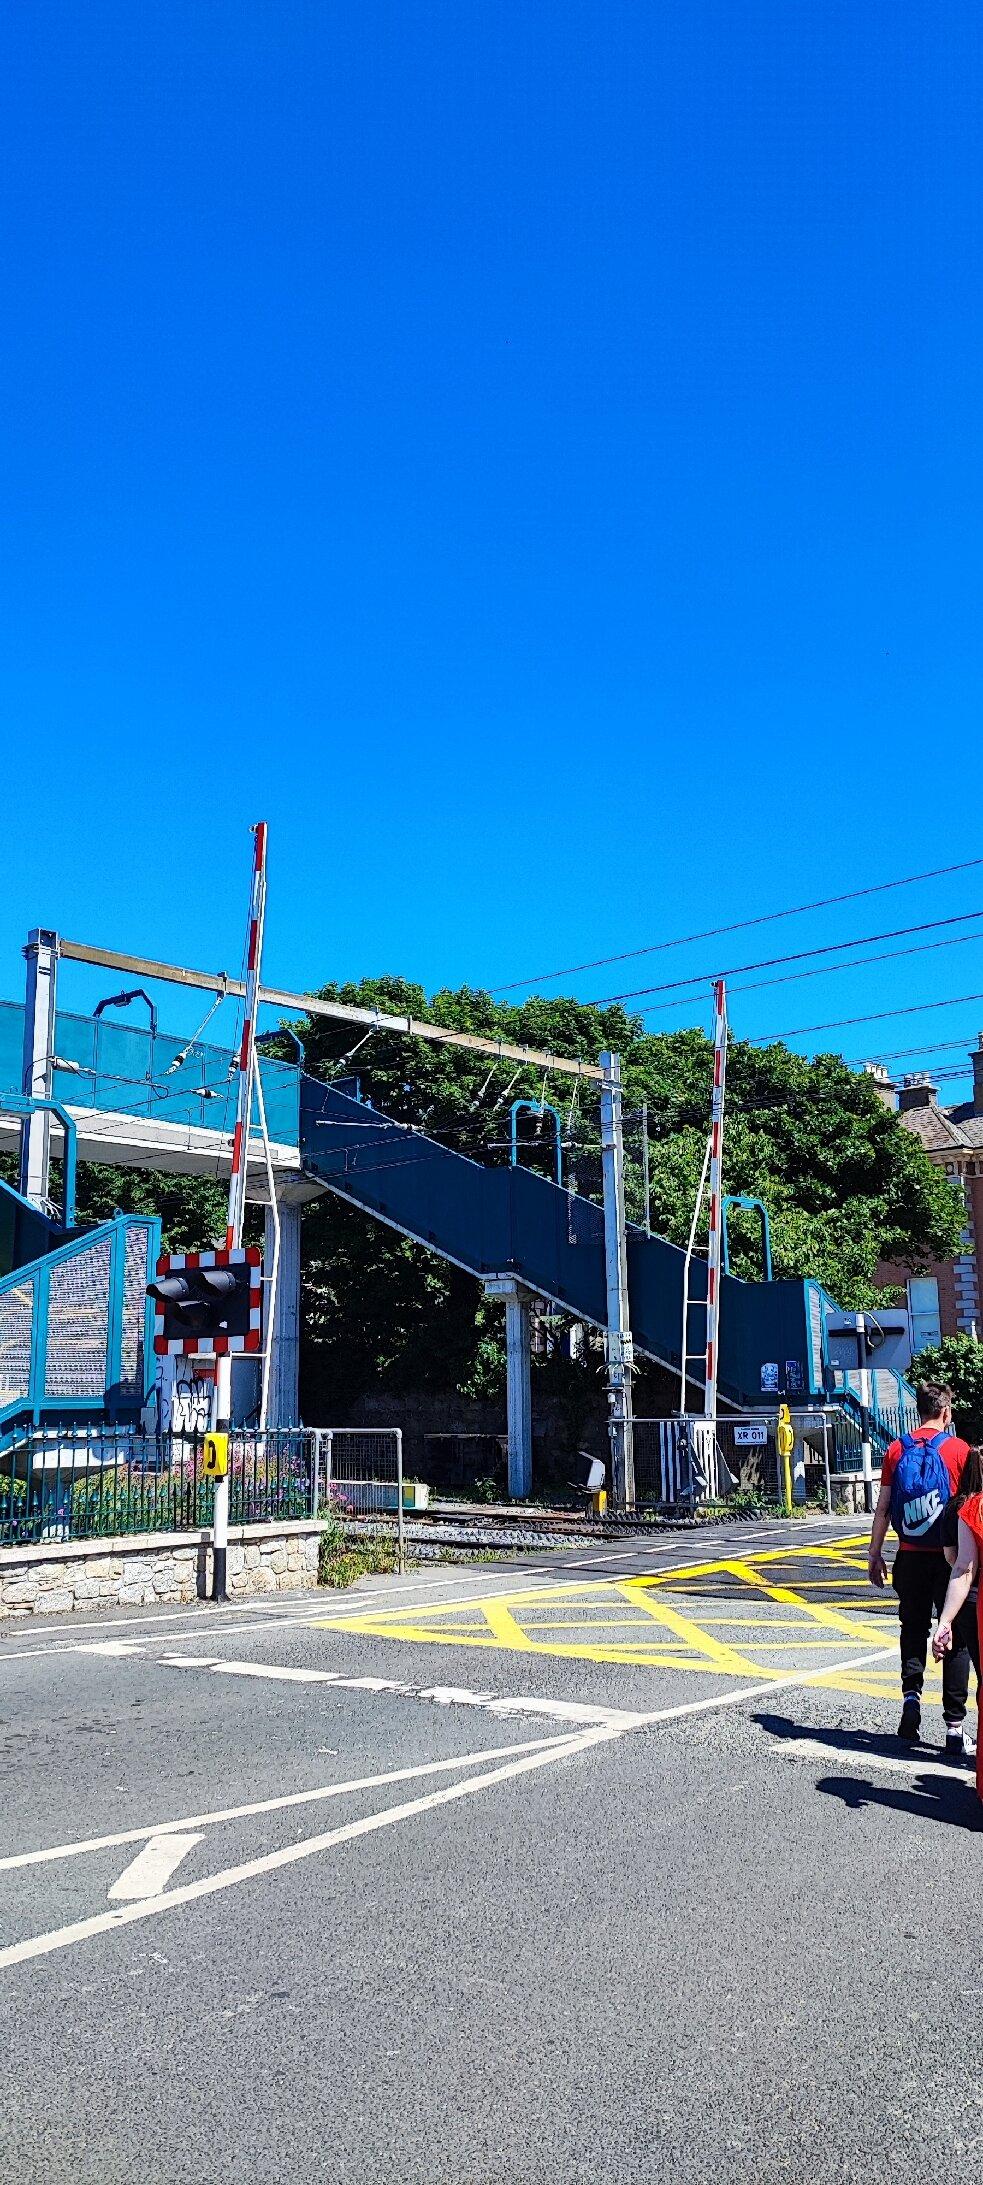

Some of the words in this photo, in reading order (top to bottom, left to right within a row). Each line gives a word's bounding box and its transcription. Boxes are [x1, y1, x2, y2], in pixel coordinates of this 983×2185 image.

[737, 1431, 749, 1440] XR
[751, 1431, 764, 1440] 011
[903, 1488, 941, 1525] NIKE
